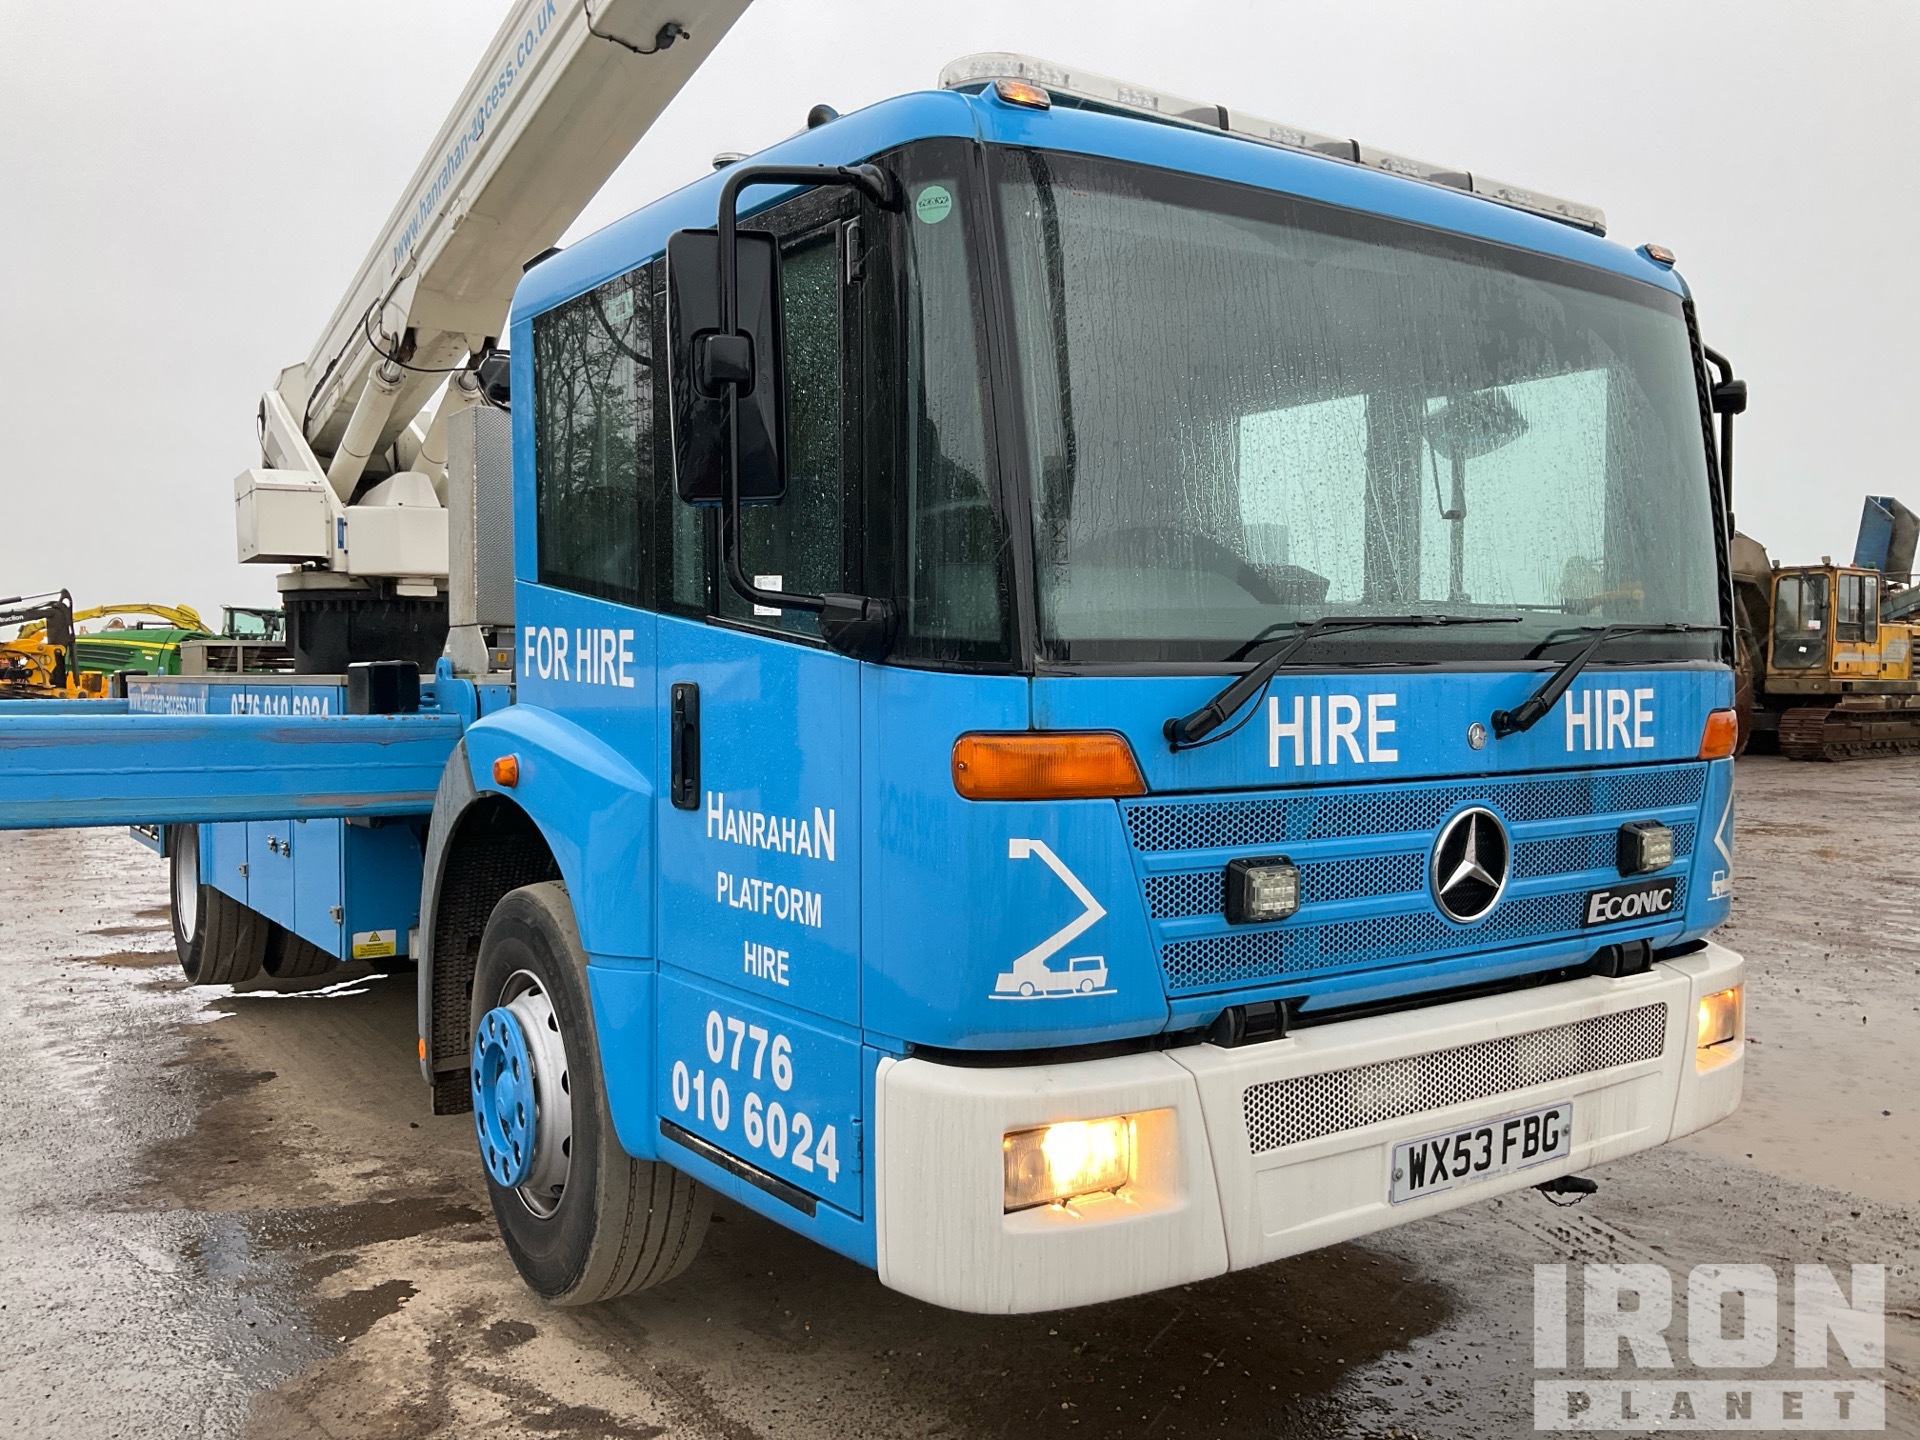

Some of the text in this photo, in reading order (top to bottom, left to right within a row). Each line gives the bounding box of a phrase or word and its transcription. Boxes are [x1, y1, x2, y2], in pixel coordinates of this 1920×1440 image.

[524, 626, 635, 688] FOR HIRE
[1268, 693, 1399, 768] HIRE
[1565, 687, 1655, 752] HIRE
[707, 790, 836, 862] HANRAHAN
[716, 871, 822, 929] PLATFORM
[1587, 888, 1673, 924] ECONIC
[743, 940, 790, 987] HIRE
[705, 1010, 793, 1092] 0776
[672, 1060, 840, 1184] 010 6024
[1408, 1110, 1560, 1191] WX53 FBG
